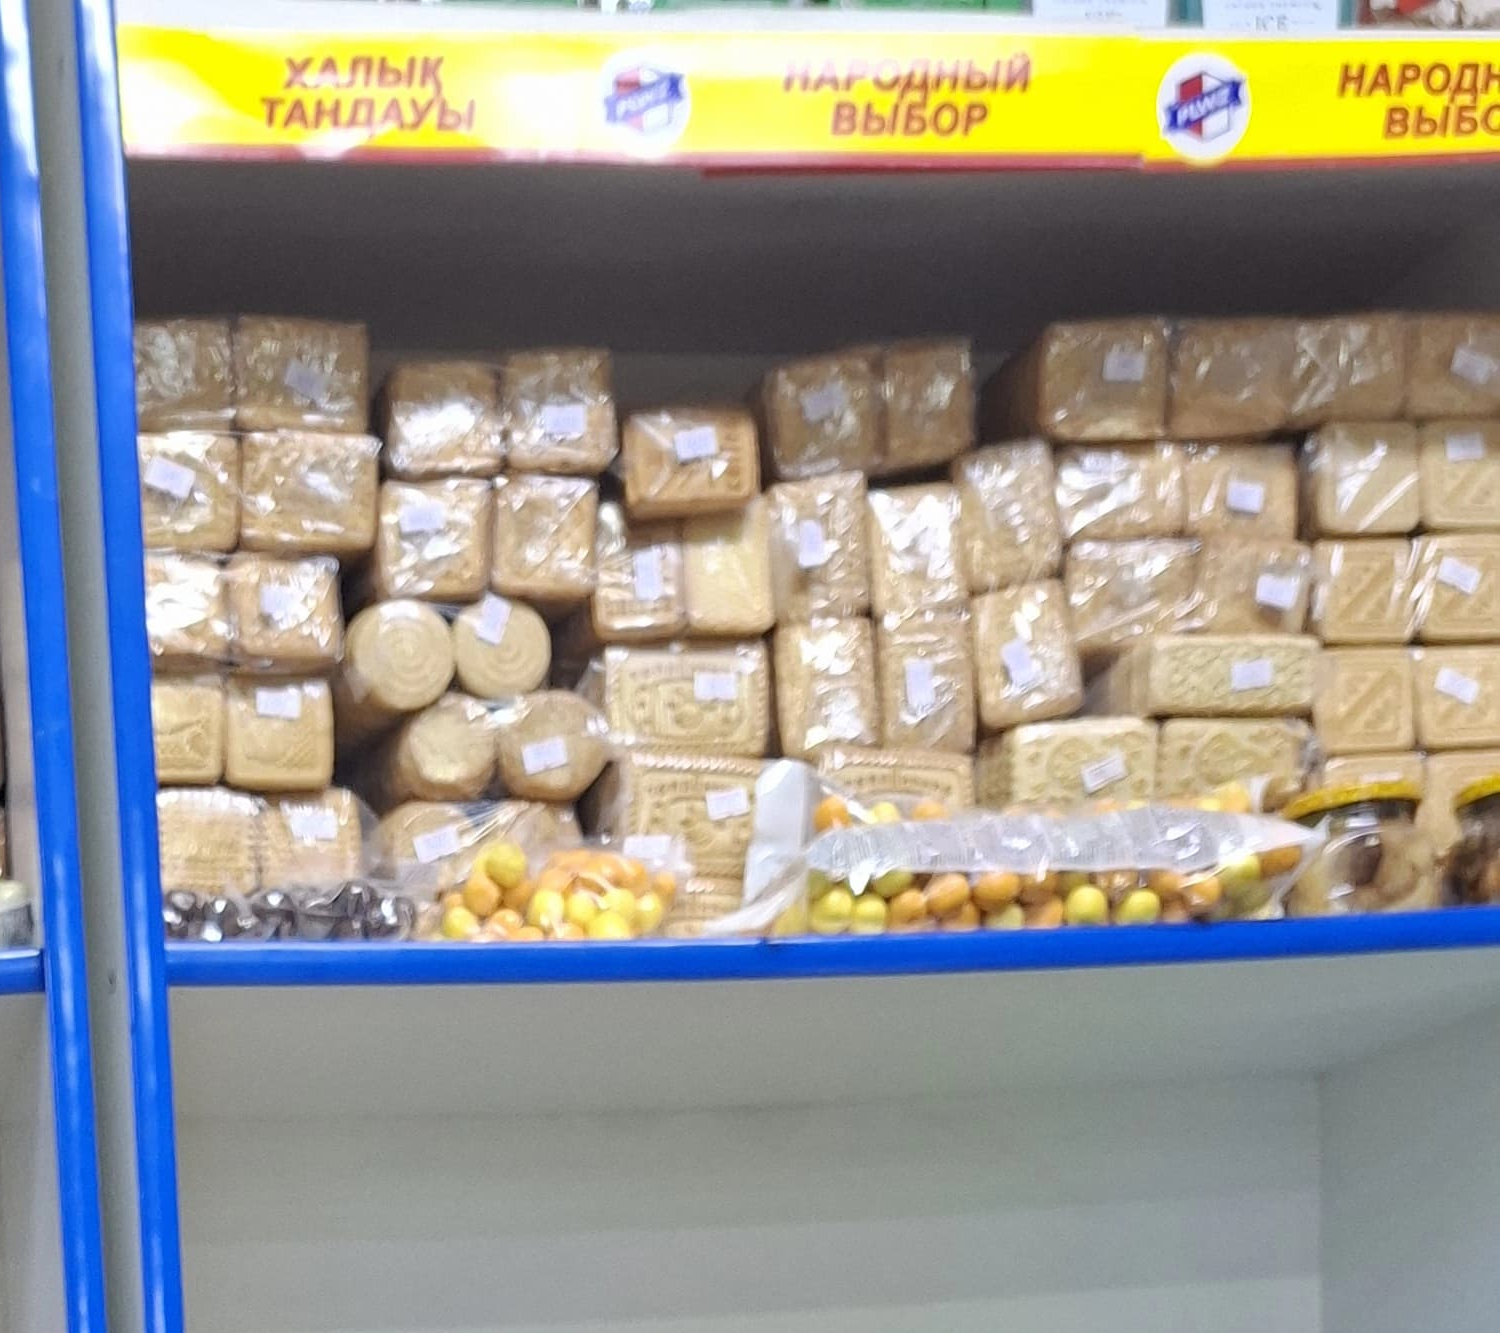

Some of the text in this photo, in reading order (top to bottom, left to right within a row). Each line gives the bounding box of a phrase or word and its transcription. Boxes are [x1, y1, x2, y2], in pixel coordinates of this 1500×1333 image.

[284, 56, 444, 97] ХАЛЫҚ
[783, 51, 1031, 107] НАРОДНЫЙ
[831, 102, 988, 136] ВЫБОР
